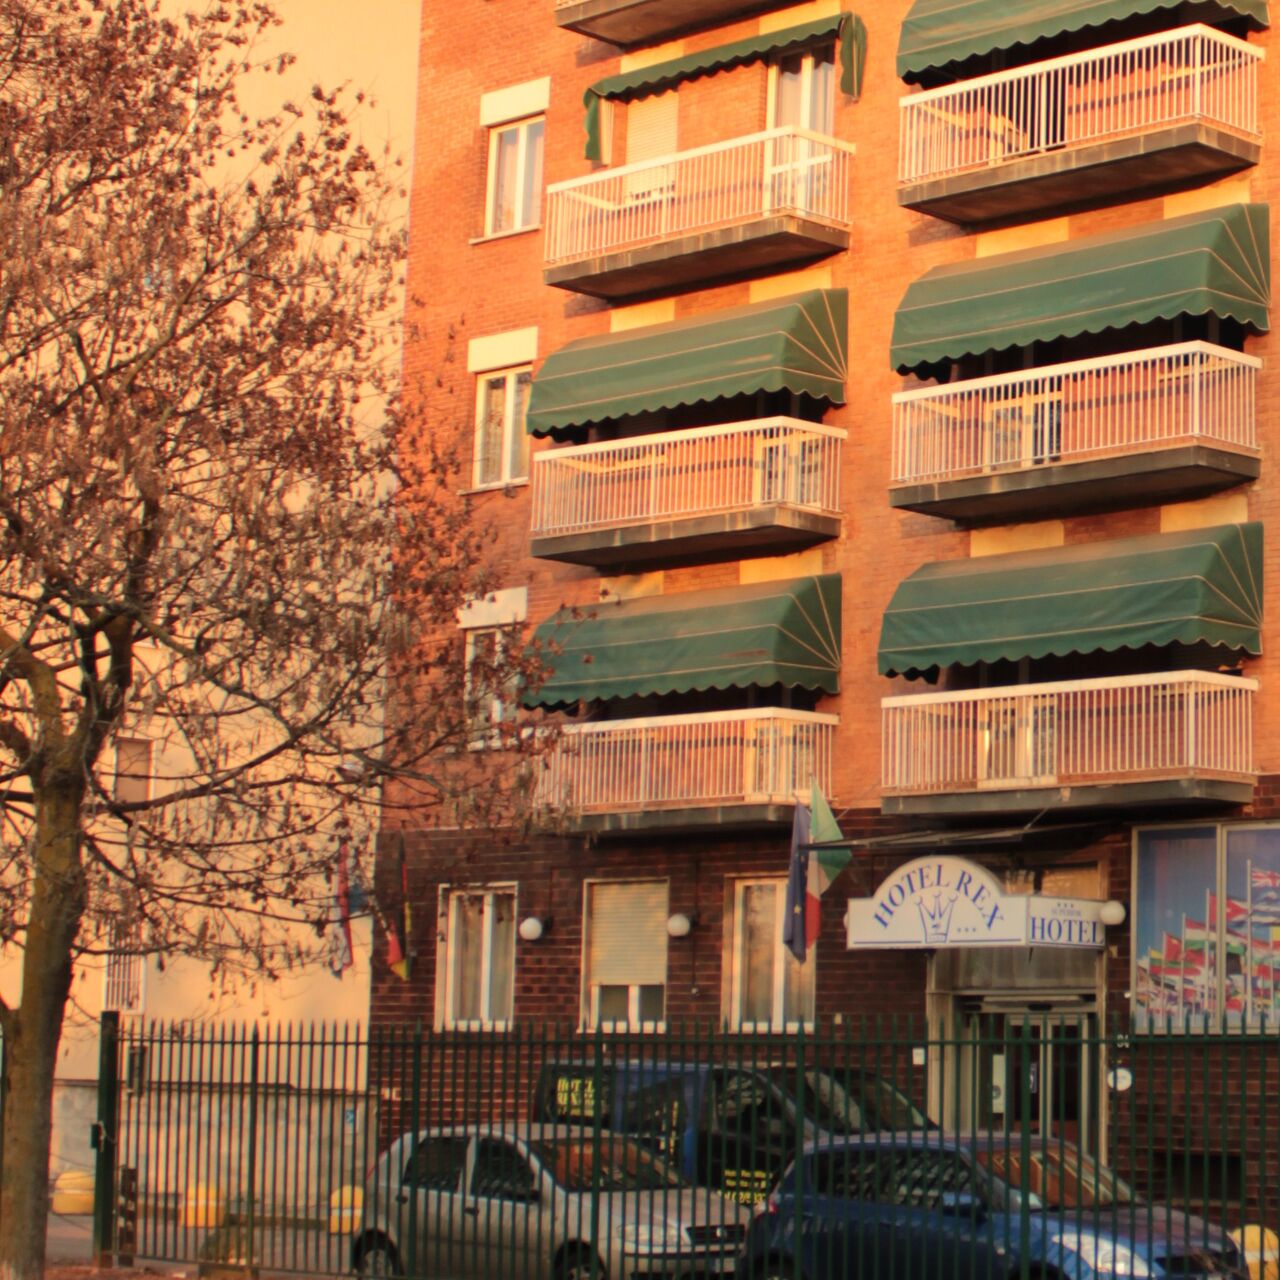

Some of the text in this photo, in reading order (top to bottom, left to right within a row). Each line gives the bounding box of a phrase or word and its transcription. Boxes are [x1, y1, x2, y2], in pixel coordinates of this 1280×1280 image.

[872, 863, 1005, 930] HOTEL REX
[1031, 916, 1105, 944] HOTEL
